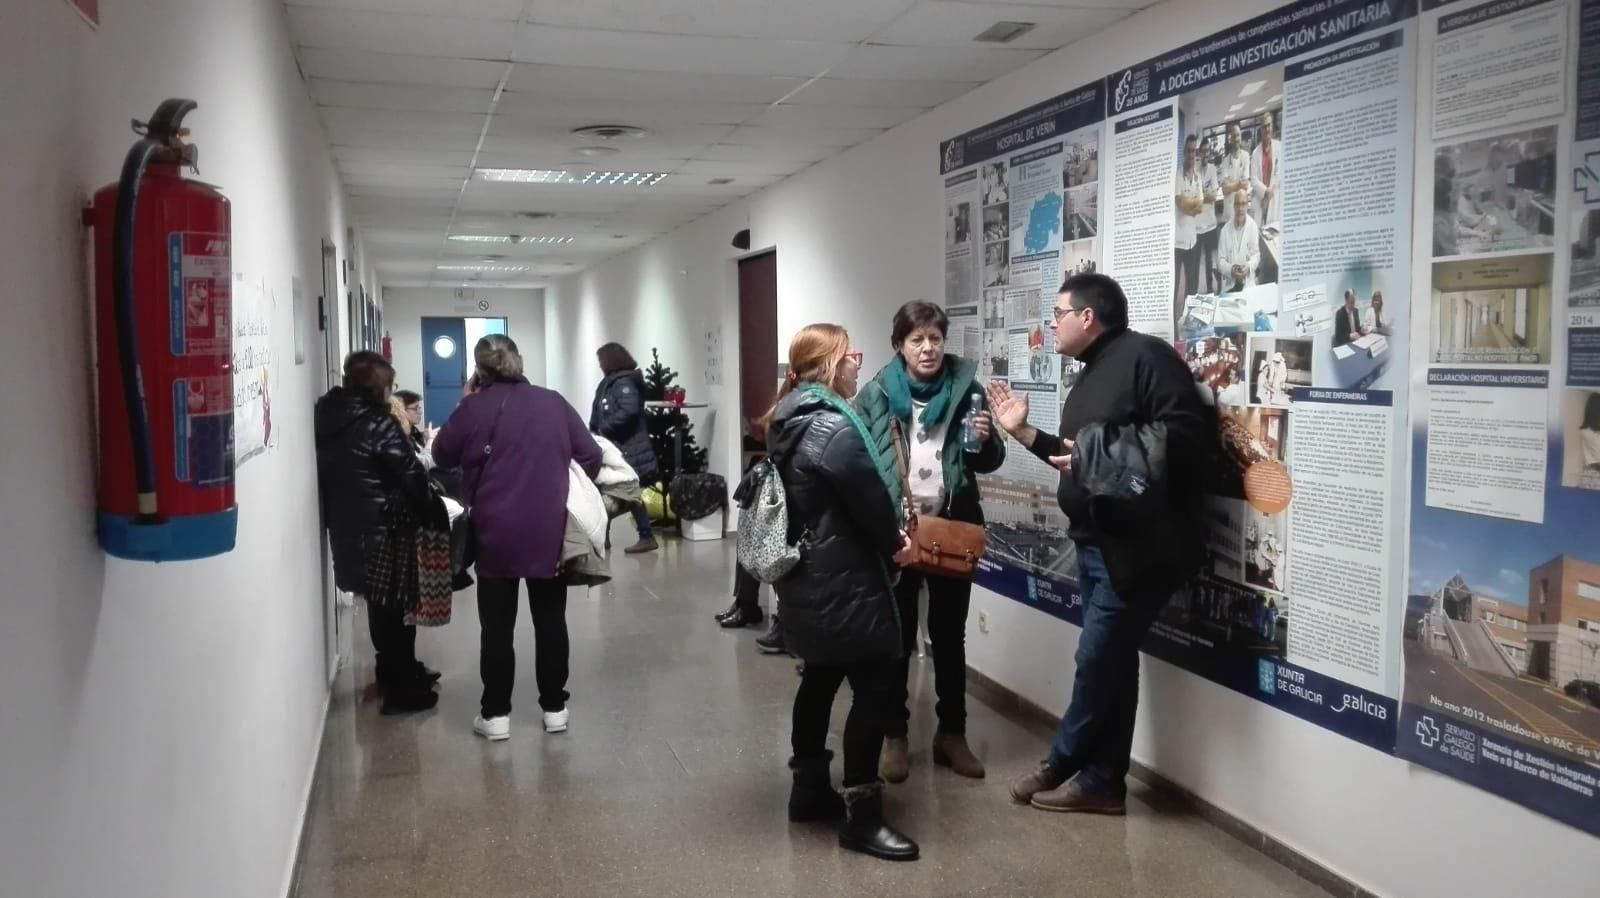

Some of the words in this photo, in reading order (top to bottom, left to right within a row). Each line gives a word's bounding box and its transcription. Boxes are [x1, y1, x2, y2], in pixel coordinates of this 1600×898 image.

[1238, 30, 1247, 41] de
[1248, 13, 1291, 37] competencias
[1292, 2, 1327, 21] sanitarias
[1159, 79, 1166, 94] A
[1168, 61, 1218, 91] DOCENCIA
[1220, 57, 1226, 74] E
[1229, 23, 1317, 70] INVESTIGACIÓN
[1319, 1, 1392, 39] SANITARIA
[1126, 98, 1133, 107] 25
[1134, 92, 1148, 104] ANOS
[996, 131, 1024, 151] HOSPITAL
[1026, 128, 1034, 140] DE
[1571, 316, 1593, 325] 2014
[1429, 373, 1469, 382] DECLARACIÓN
[1471, 374, 1499, 383] HOSPITAL
[1500, 375, 1546, 384] UNIVERSITARIO
[1276, 665, 1305, 684] XUNTA
[1277, 678, 1288, 691] DE
[1288, 683, 1323, 705] GALICIA
[1330, 693, 1387, 720] galicia
[1430, 695, 1443, 707] No
[1444, 702, 1460, 713] ano
[1462, 706, 1485, 722] 2012
[1487, 716, 1541, 741] trasladouse
[1543, 736, 1550, 744] o
[1553, 737, 1574, 752] PAC
[1577, 744, 1590, 757] de
[1445, 723, 1476, 742] SERVIZO
[1440, 744, 1449, 754] de
[1443, 734, 1475, 752] GALEGO
[1482, 737, 1513, 756] Xerencia
[1514, 749, 1525, 759] de
[1556, 762, 1596, 786] Integrada
[1514, 759, 1538, 775] Barco
[1539, 769, 1550, 780] de
[1551, 773, 1594, 797] Valdeorras
